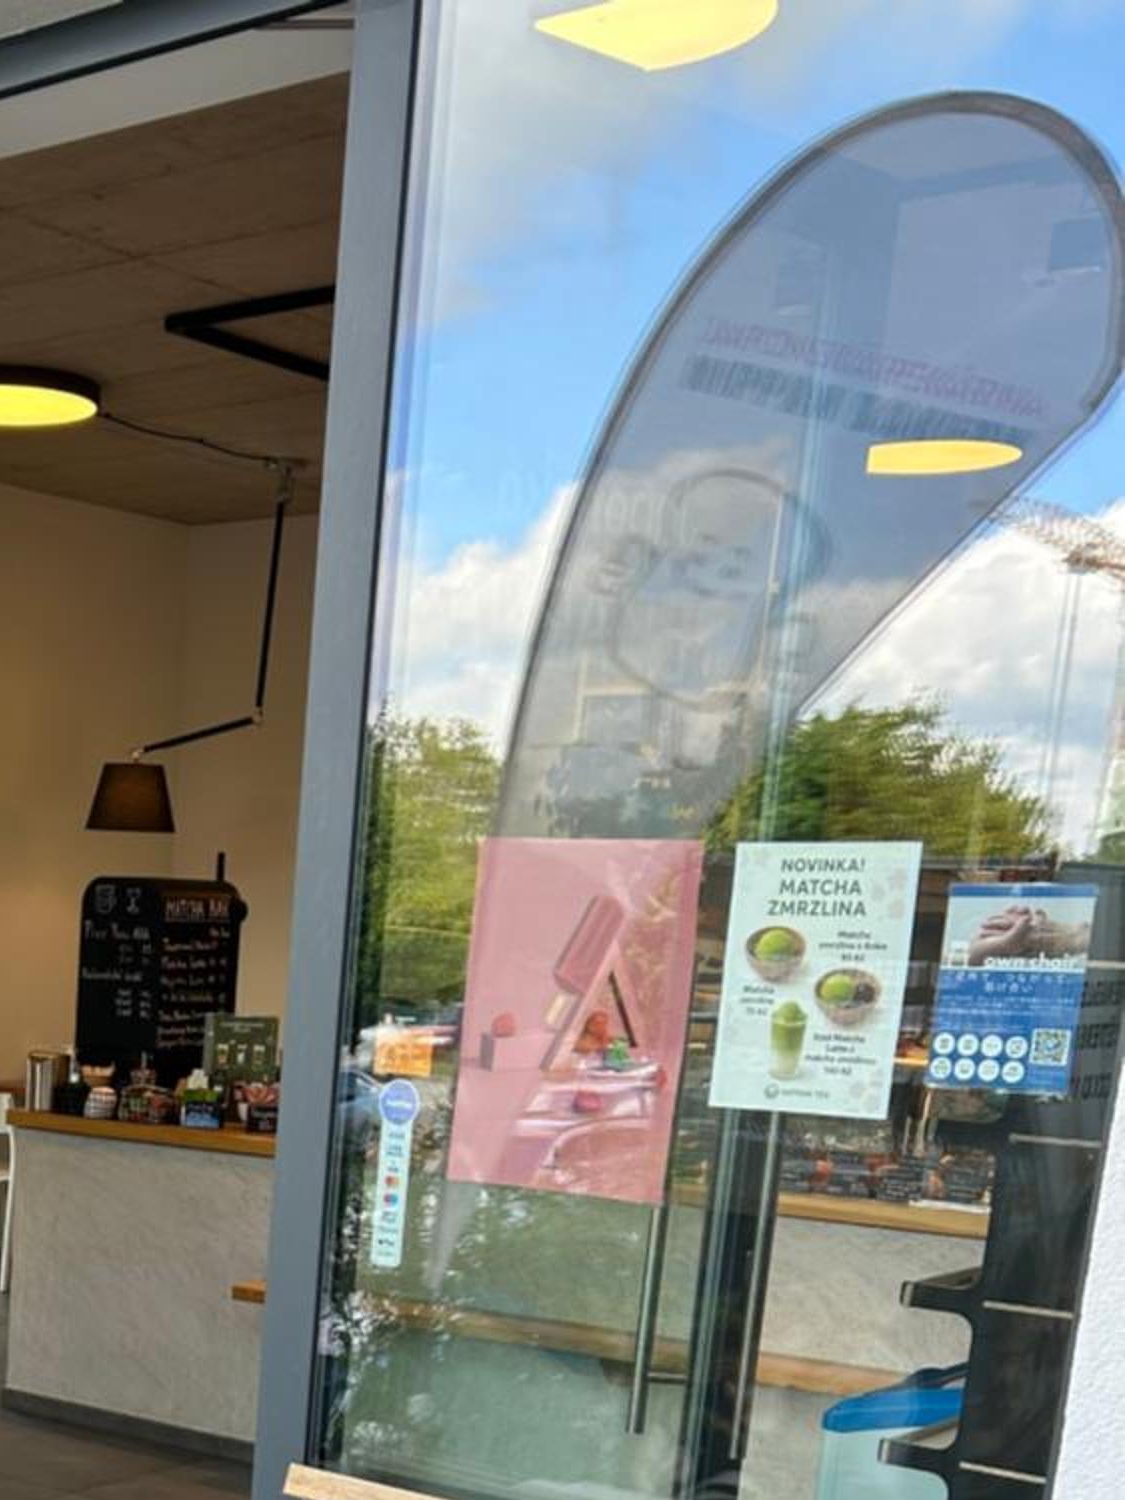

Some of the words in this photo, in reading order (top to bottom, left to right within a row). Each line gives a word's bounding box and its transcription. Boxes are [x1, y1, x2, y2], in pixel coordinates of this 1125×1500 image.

[780, 858, 866, 873] NOVINKA!
[779, 879, 862, 895] MATCHA
[767, 900, 867, 917] ZMRZLINA
